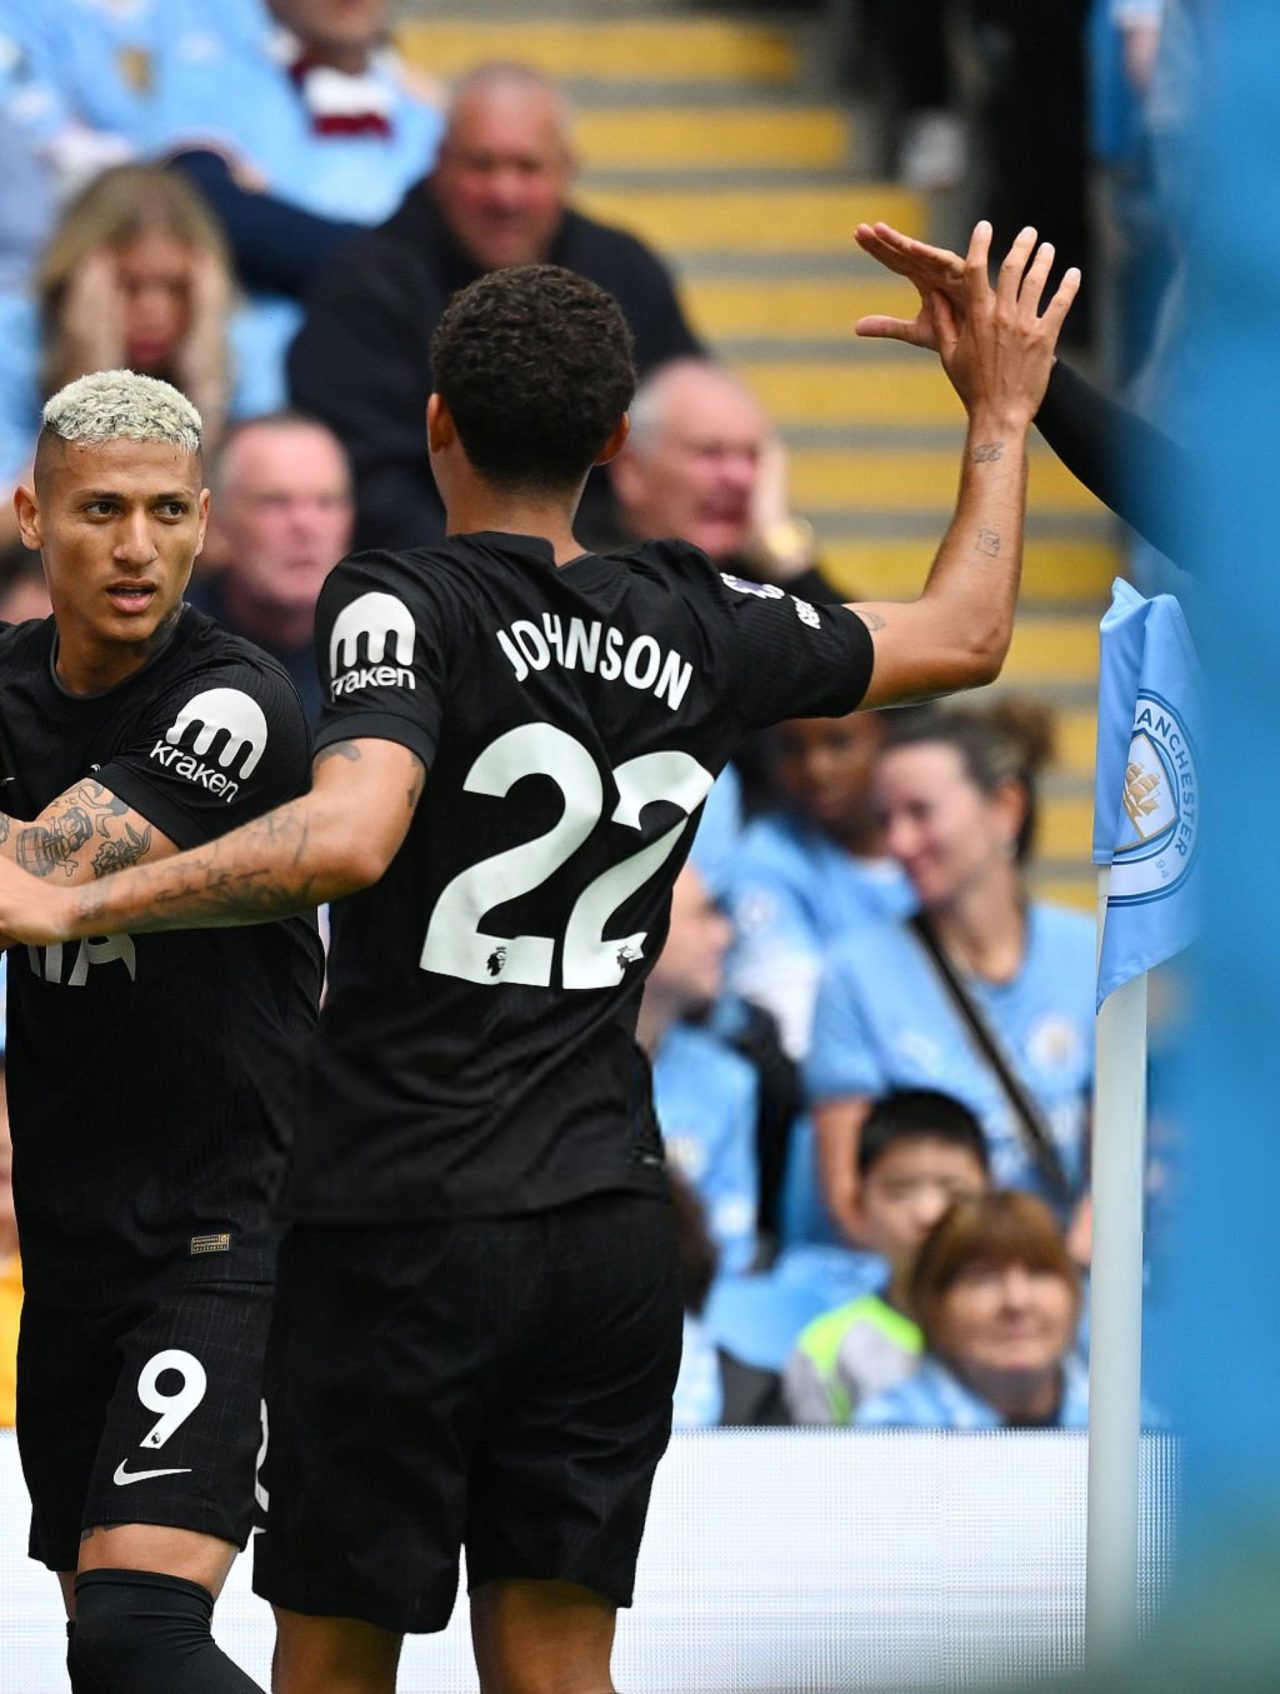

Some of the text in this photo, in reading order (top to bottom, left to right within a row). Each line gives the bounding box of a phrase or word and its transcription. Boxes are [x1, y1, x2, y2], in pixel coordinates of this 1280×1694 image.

[496, 612, 693, 711] JOHNSON
[149, 740, 239, 803] kraken
[1133, 707, 1197, 858] ANCHESTER
[420, 722, 716, 990] 22
[137, 1349, 208, 1449] 9
